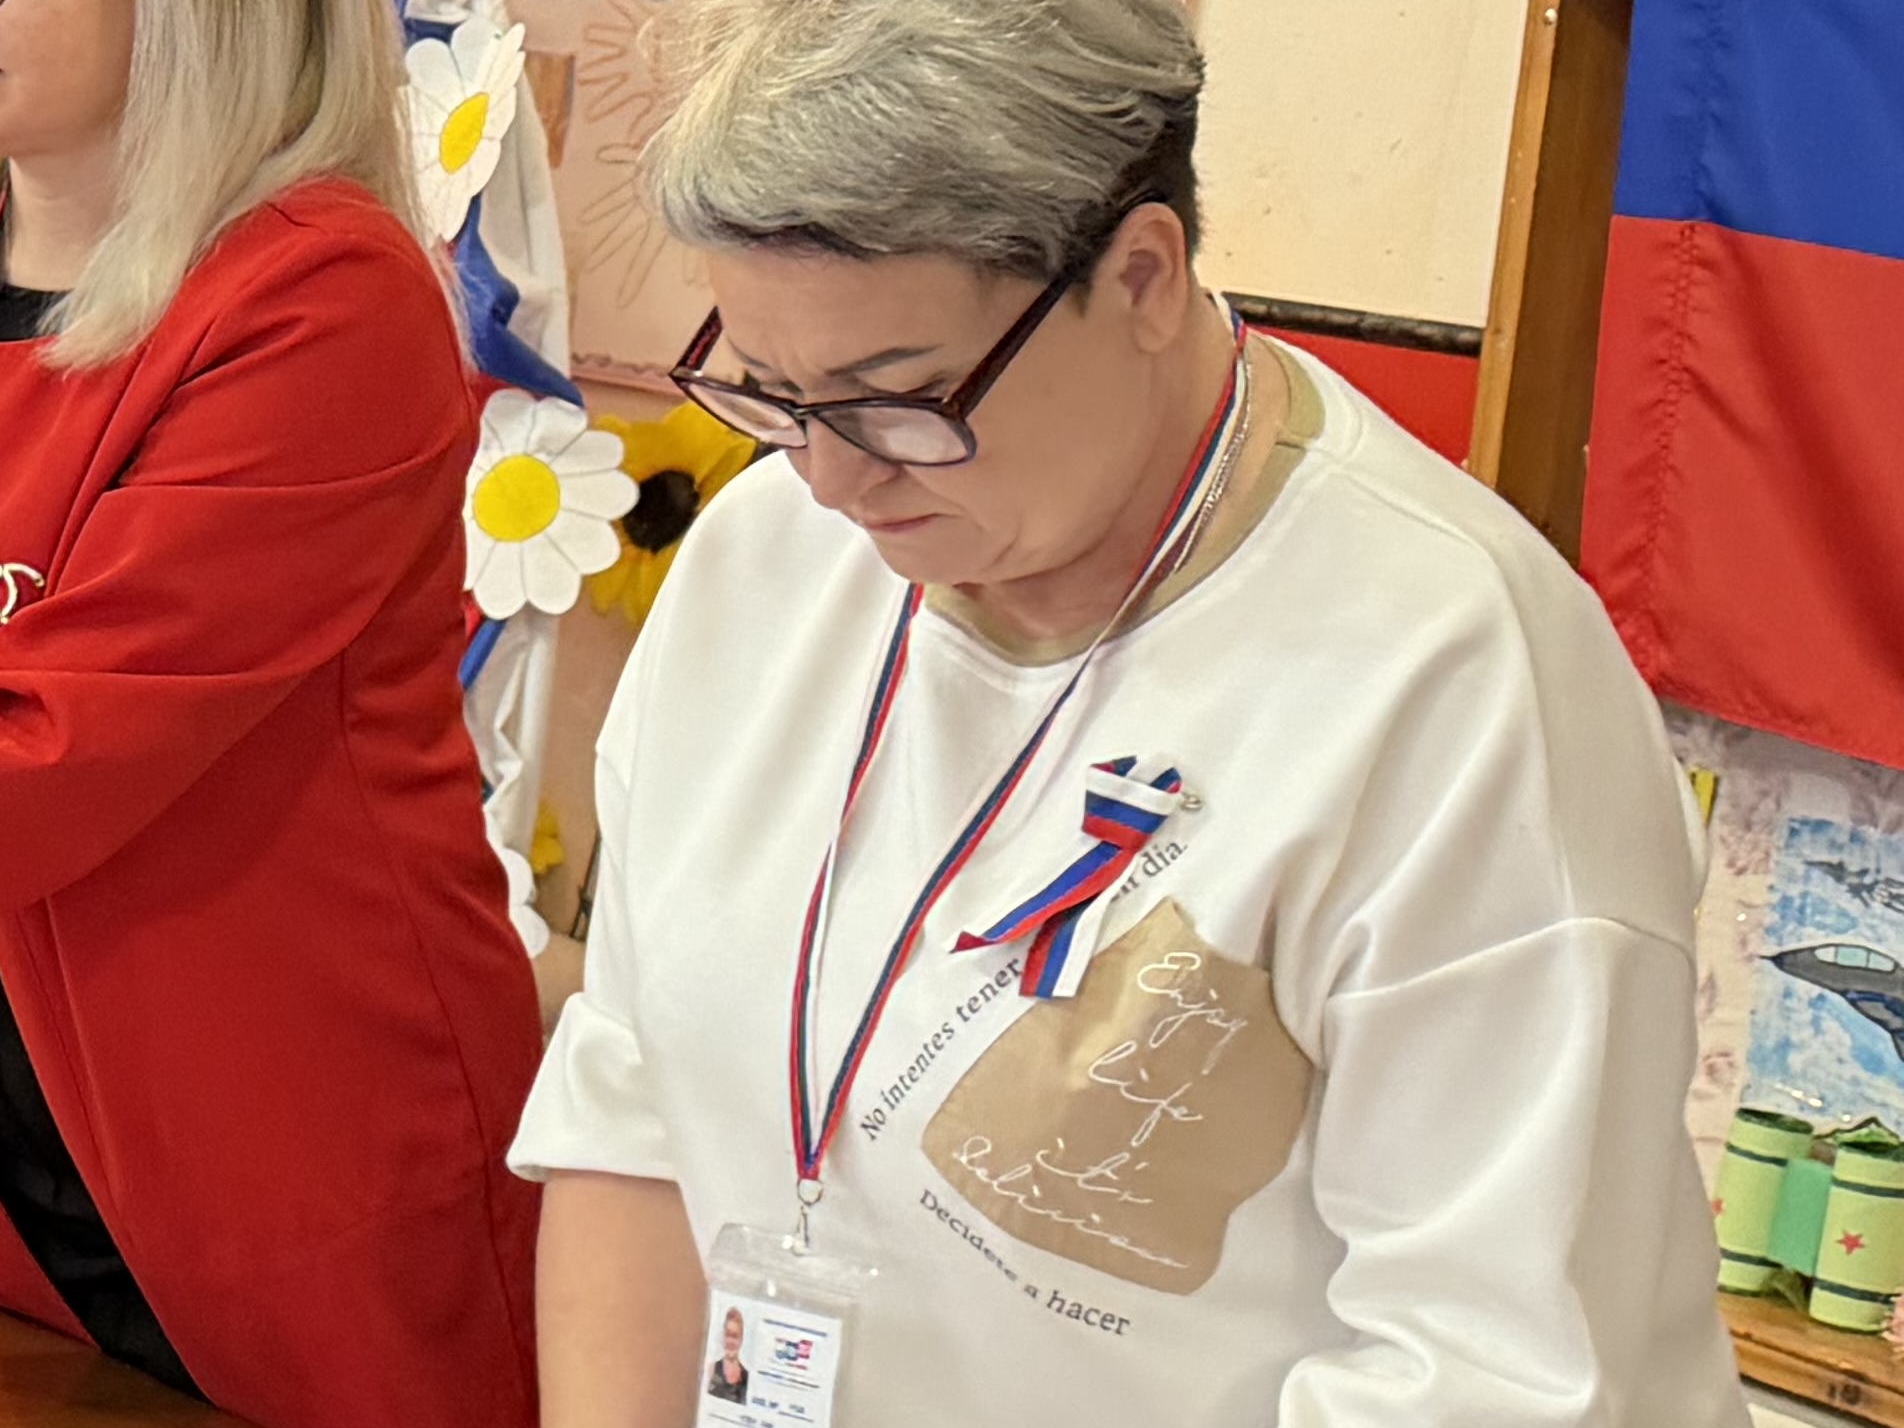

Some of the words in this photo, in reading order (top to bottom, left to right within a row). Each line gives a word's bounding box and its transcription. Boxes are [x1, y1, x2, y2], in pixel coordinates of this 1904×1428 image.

[860, 1105, 885, 1141] No
[882, 1018, 955, 1109] intentes
[955, 957, 1024, 1023] tener
[1045, 1290, 1132, 1337] hacer
